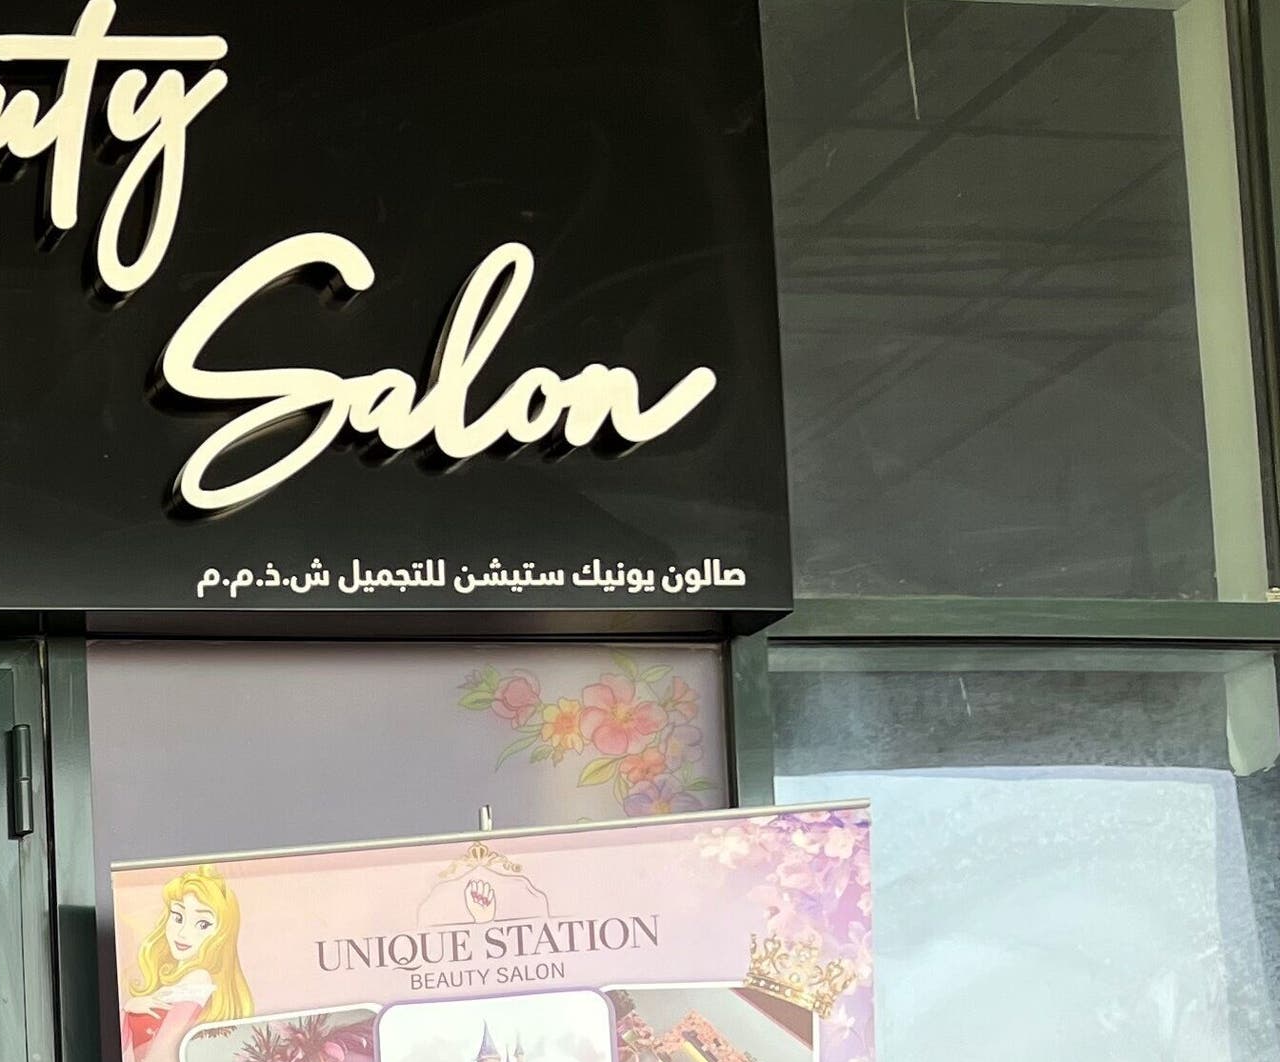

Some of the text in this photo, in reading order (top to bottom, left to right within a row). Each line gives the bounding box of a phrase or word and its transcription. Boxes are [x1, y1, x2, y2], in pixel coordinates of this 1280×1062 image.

[163, 233, 717, 510] Salon
[339, 558, 445, 594] للتجميل
[454, 557, 564, 594] ستيشن
[572, 559, 655, 594] يونيك
[662, 559, 746, 594] صالون
[314, 914, 661, 972] UNIQUE STATION
[410, 962, 565, 991] BEAUTY SALON
